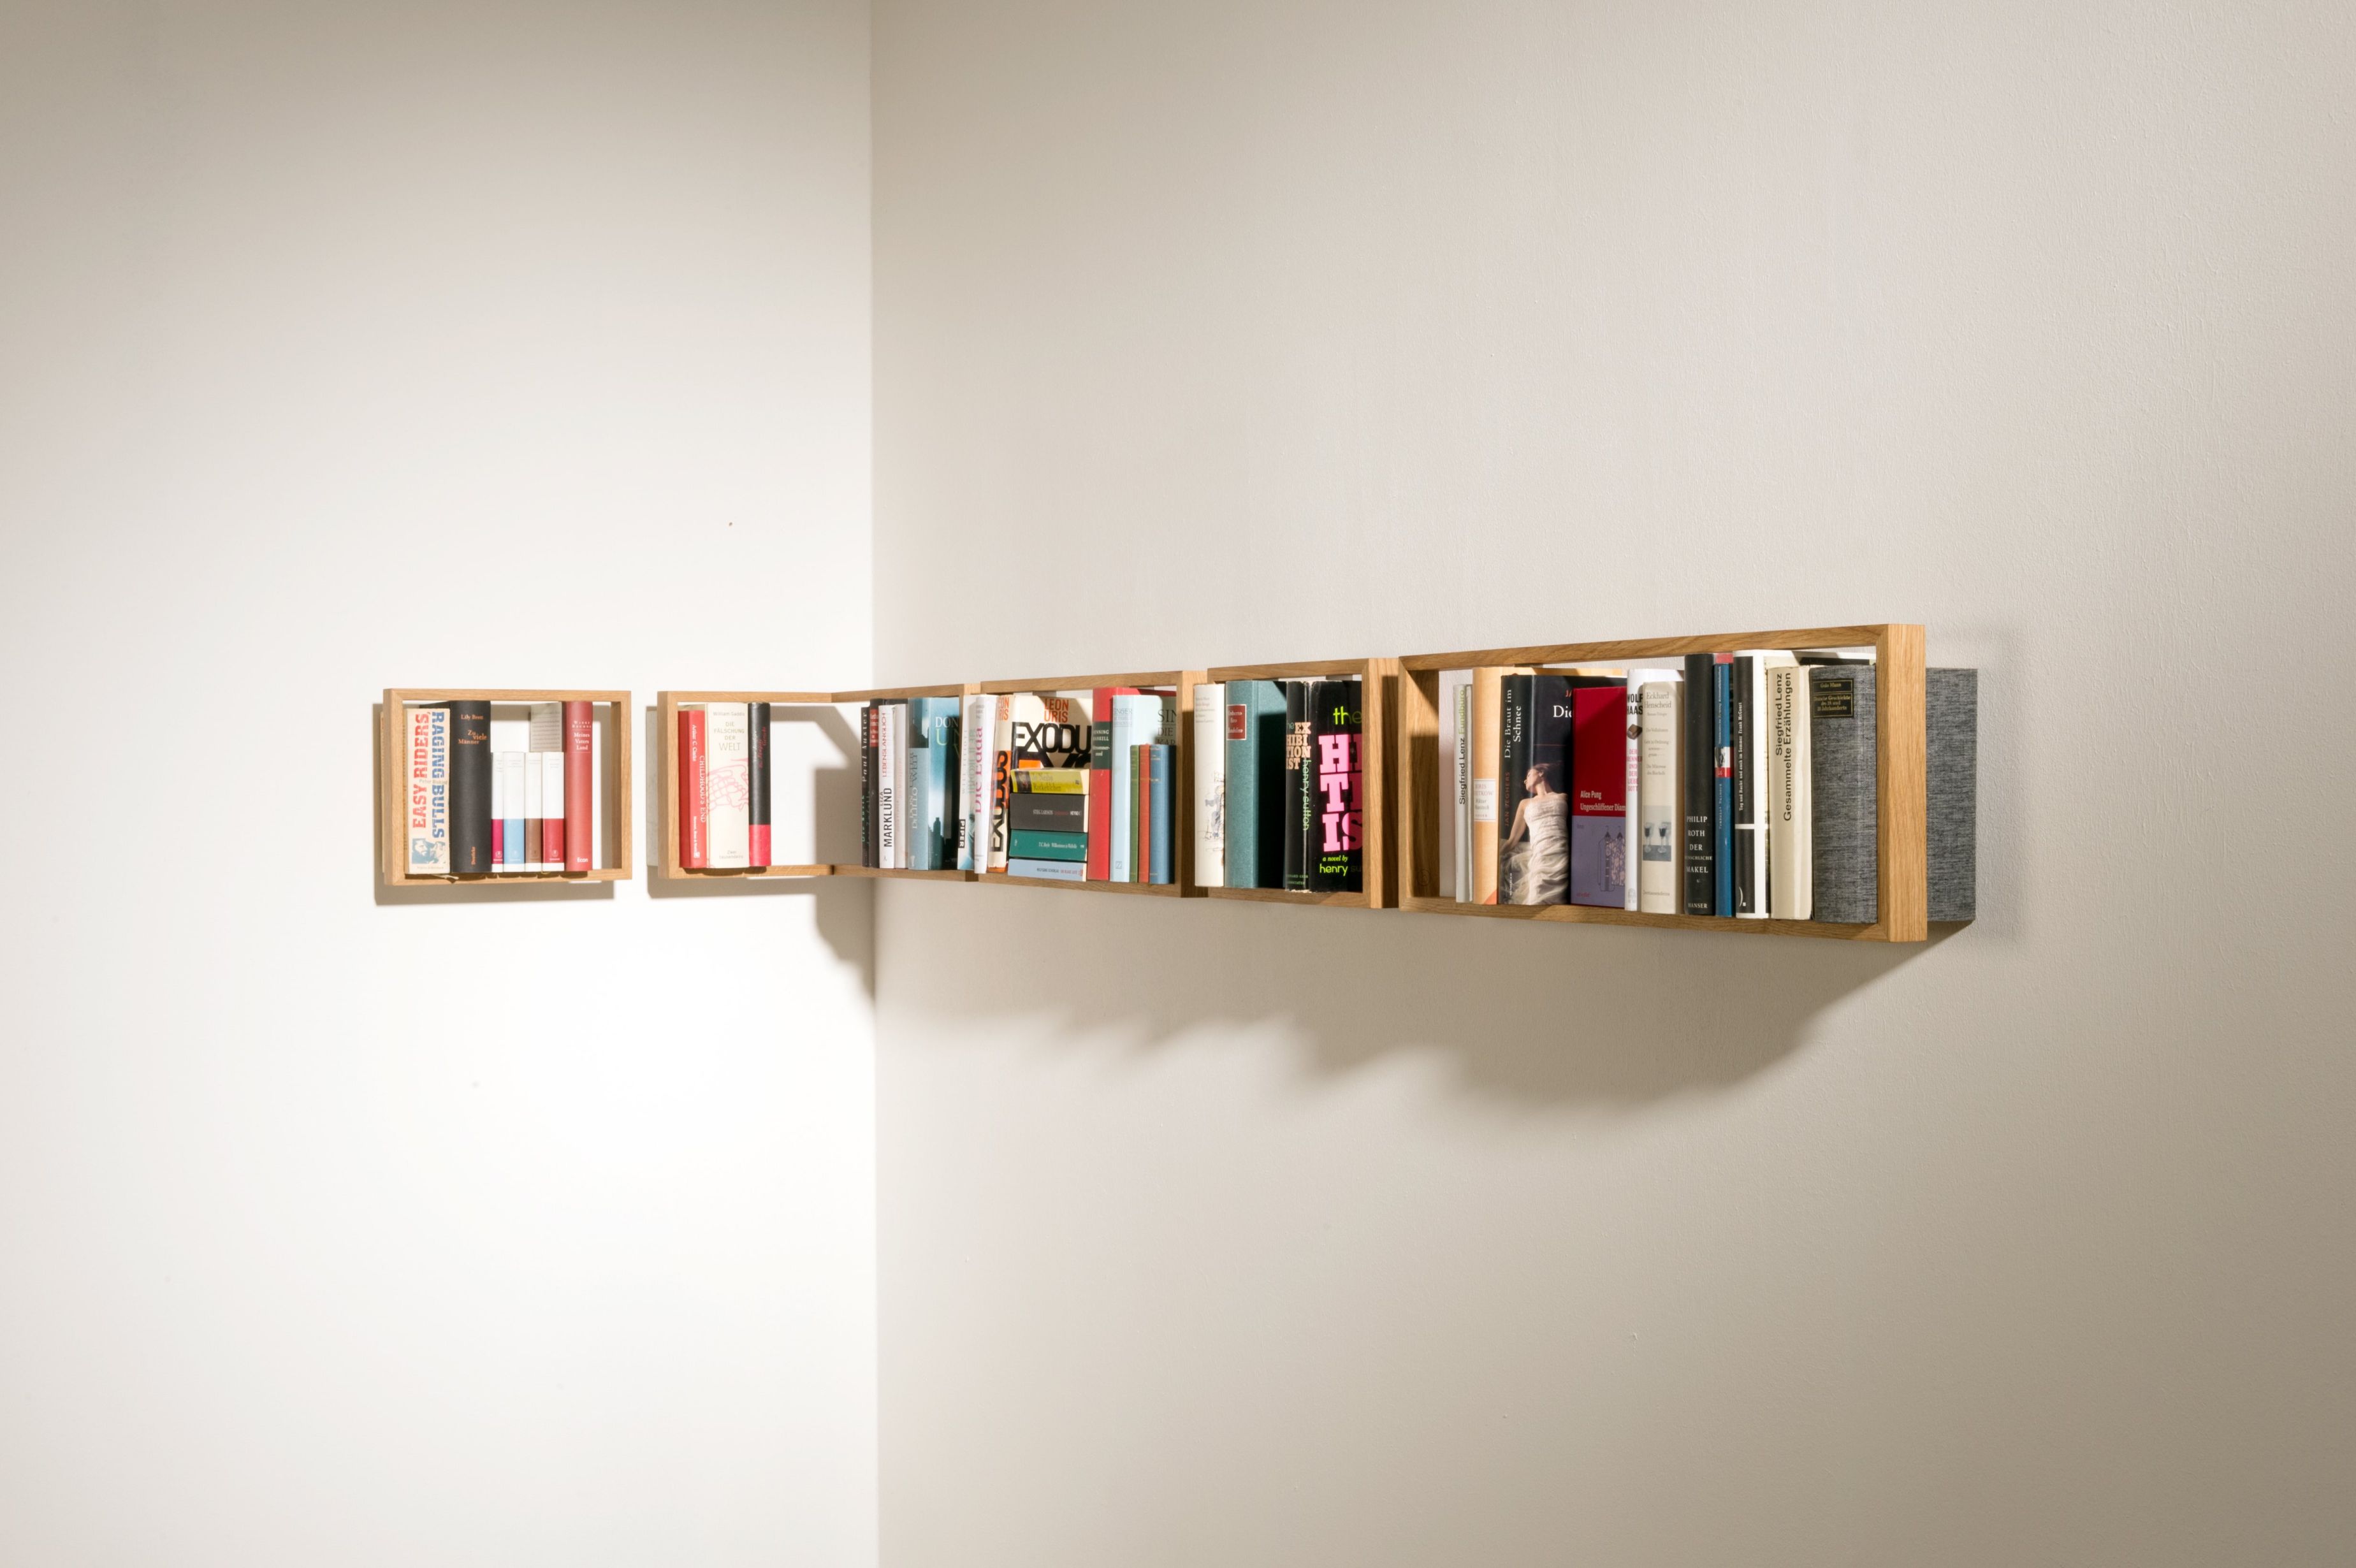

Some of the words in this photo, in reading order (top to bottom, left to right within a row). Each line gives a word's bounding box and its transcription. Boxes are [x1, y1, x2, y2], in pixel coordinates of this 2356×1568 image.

[1504, 689, 1511, 703] im
[1043, 698, 1069, 711] LEON
[1644, 701, 1671, 709] Henscheid
[1784, 672, 1793, 744] Erzählungen
[1043, 711, 1068, 723] URIS
[1332, 706, 1362, 725] the
[1513, 705, 1522, 742] Schnee
[1157, 728, 1174, 736] DIE
[432, 711, 444, 778] RAGING
[718, 743, 741, 751] WELT
[1286, 746, 1311, 758] TION
[1299, 760, 1312, 794] henry
[1783, 745, 1792, 822] Gesammelte
[1580, 790, 1590, 799] Alice
[1591, 791, 1602, 800] Pung
[413, 784, 427, 828] EASY
[432, 784, 444, 838] BULLS
[1302, 795, 1312, 831] sutton
[1580, 803, 1613, 813] Ungeschliffener
[884, 788, 892, 847] MARKLUND
[1342, 855, 1348, 864] by
[1319, 863, 1348, 876] henry
